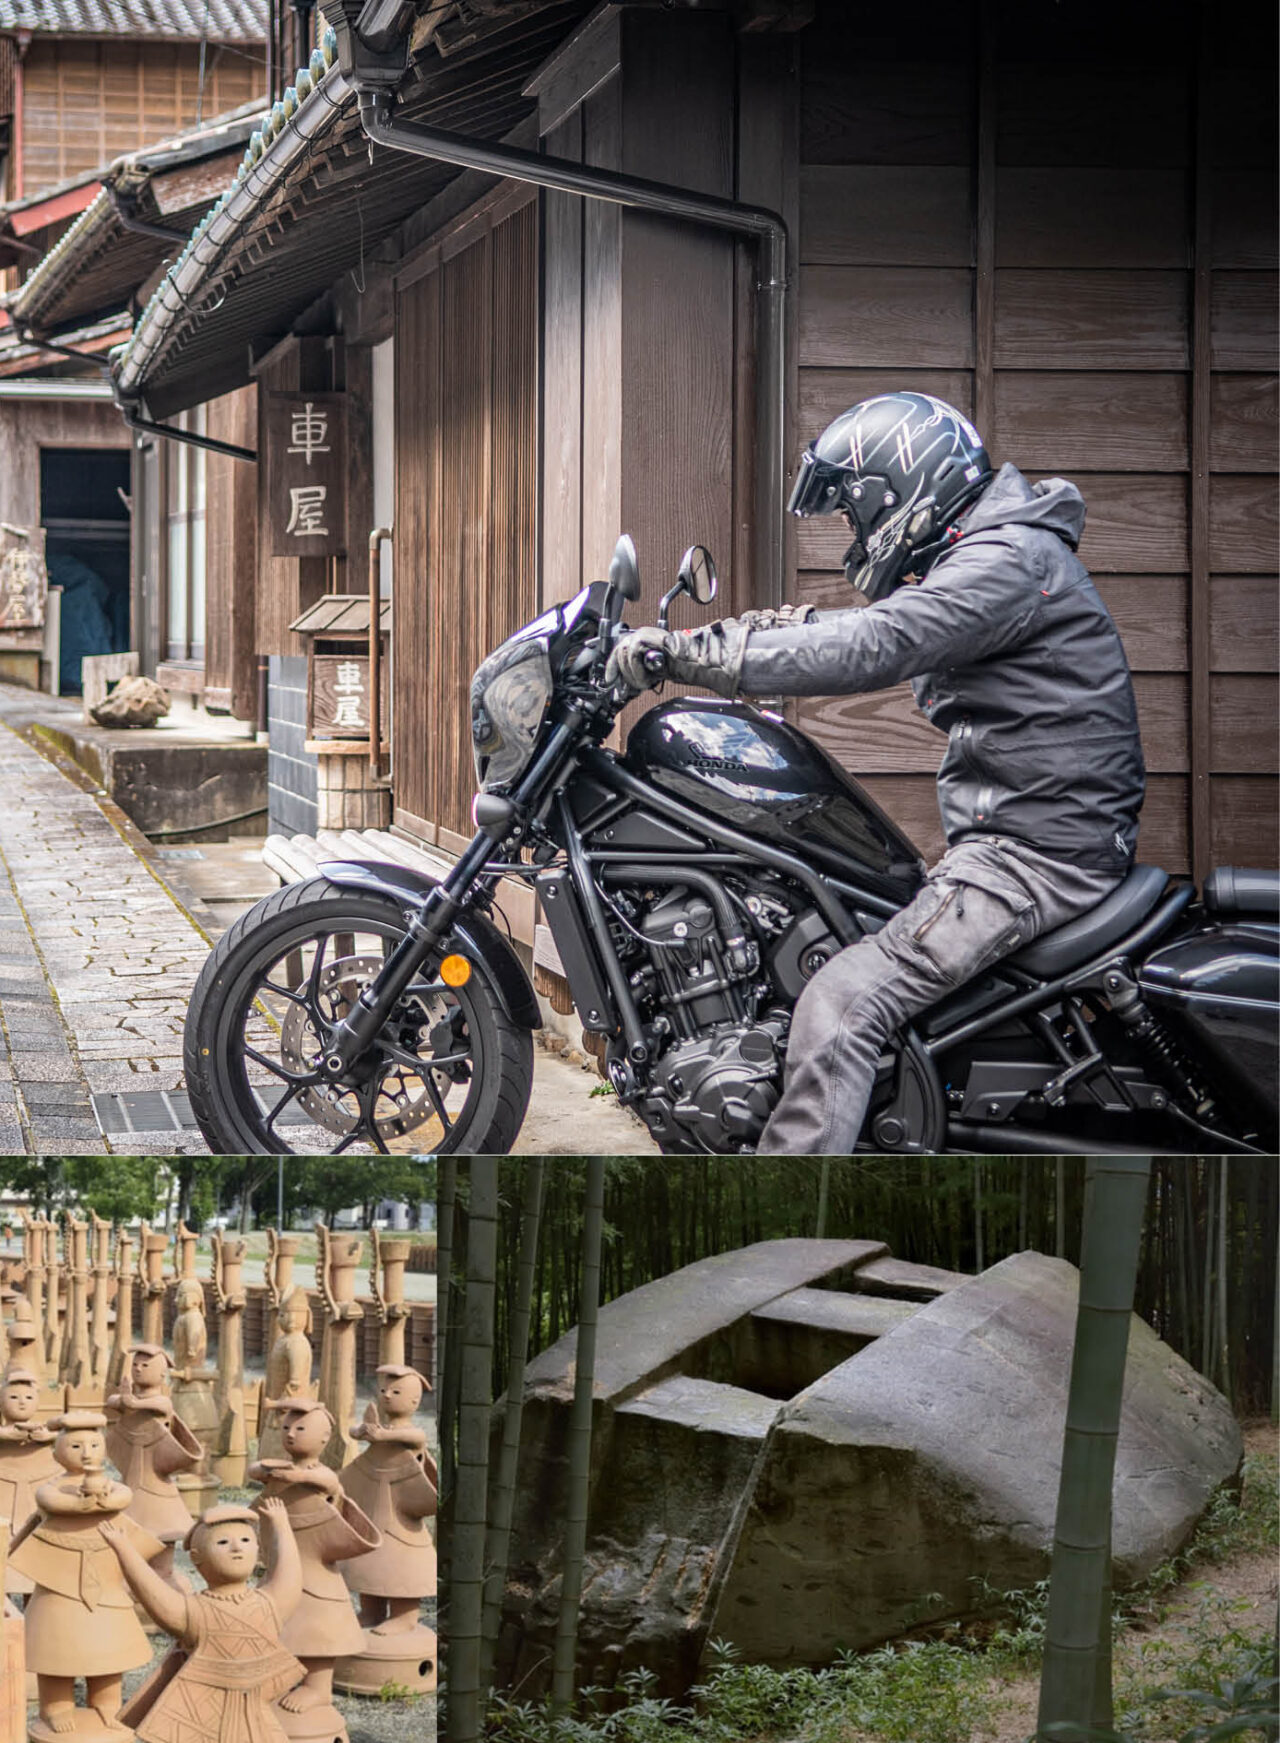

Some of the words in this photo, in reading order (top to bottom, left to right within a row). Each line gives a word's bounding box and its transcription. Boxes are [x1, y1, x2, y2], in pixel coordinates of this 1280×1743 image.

[286, 402, 330, 536] 車屋
[332, 661, 365, 727] 車屋
[687, 759, 749, 773] HONDA
